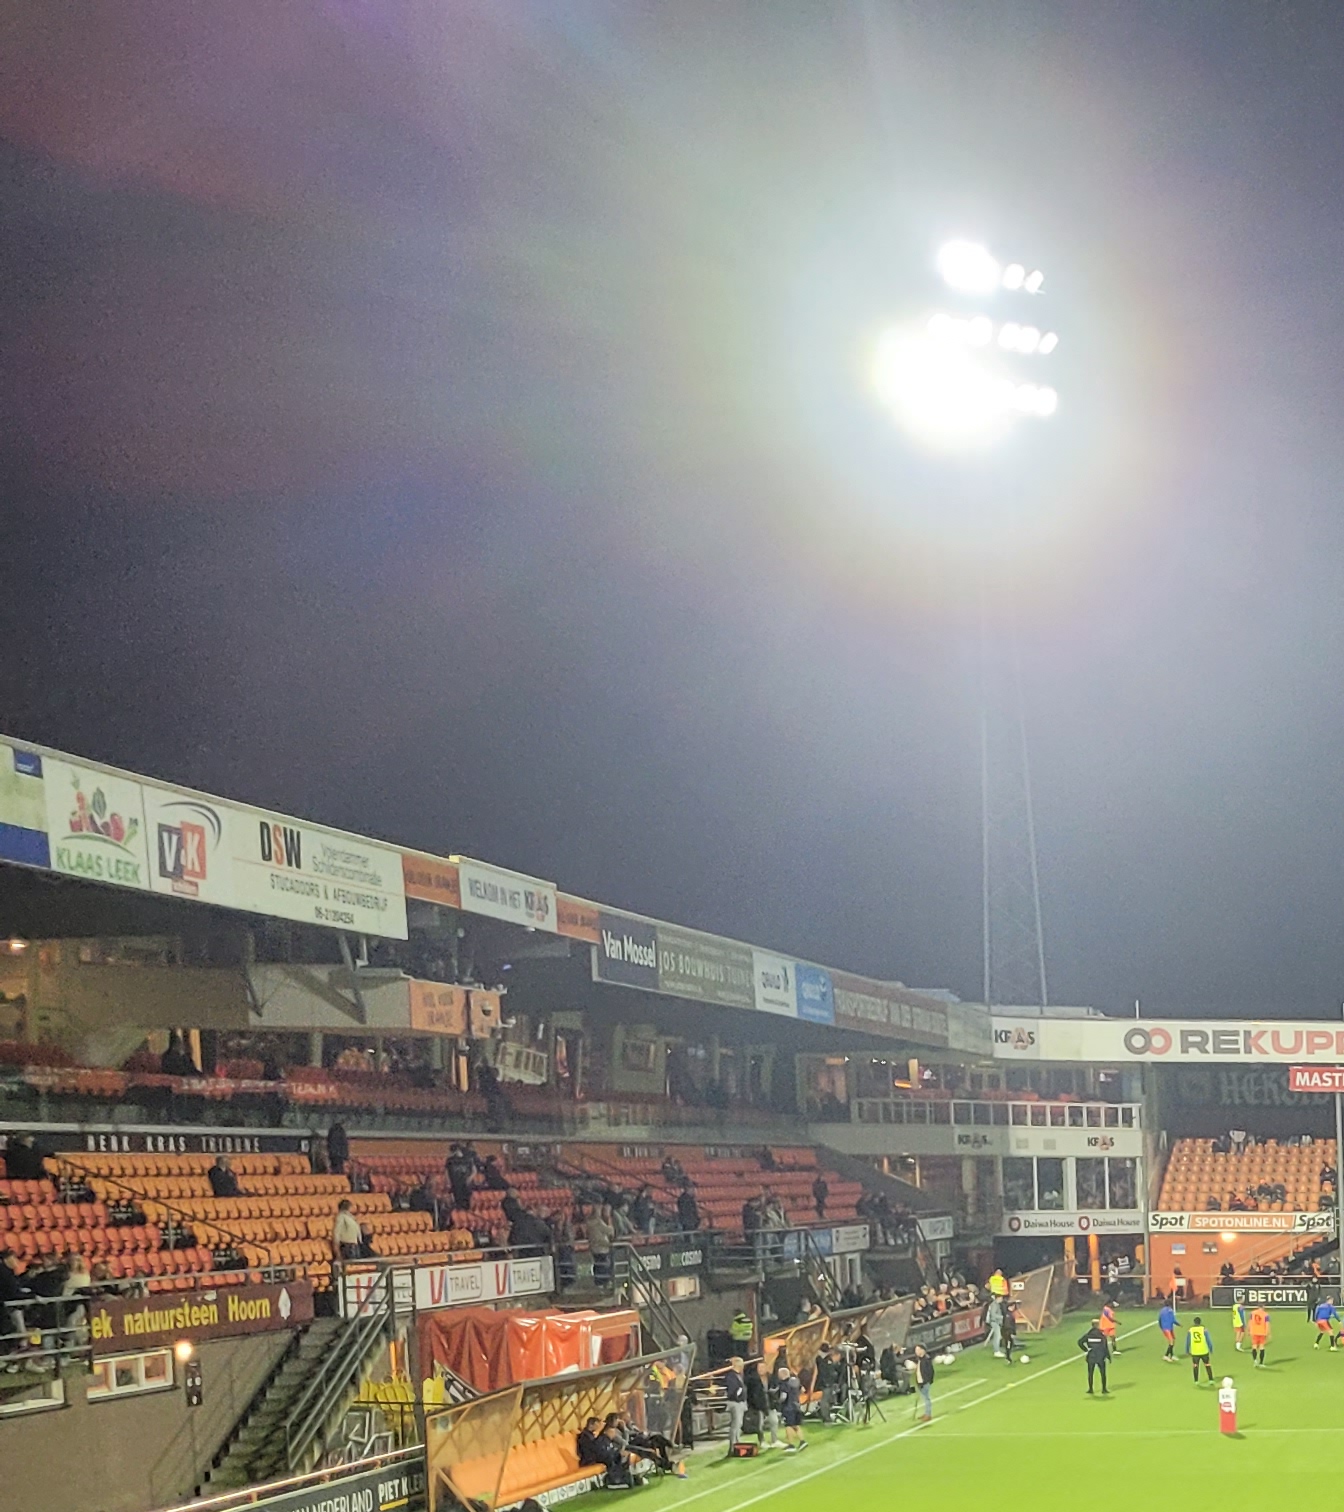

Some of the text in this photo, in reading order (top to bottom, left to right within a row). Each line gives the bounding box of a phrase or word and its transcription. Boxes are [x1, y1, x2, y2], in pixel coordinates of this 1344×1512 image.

[260, 821, 302, 869] DSW
[56, 846, 141, 884] KLAAS LEEK
[602, 930, 622, 959] Van
[624, 935, 656, 968] Mossel
[659, 951, 675, 974] JOS
[87, 1135, 260, 1152] HENK KRAS TRIBUNE
[1024, 1219, 1075, 1228] Daiwa House
[1093, 1218, 1141, 1227] Daiwa House
[1151, 1214, 1184, 1229] Spot
[1195, 1217, 1289, 1228] SPOTONLINE.NL
[450, 1274, 480, 1293] TRAVEL
[512, 1268, 540, 1285] TRAVEL
[124, 1295, 271, 1335] natuursteen Hoorn
[378, 1481, 399, 1504] PIET
